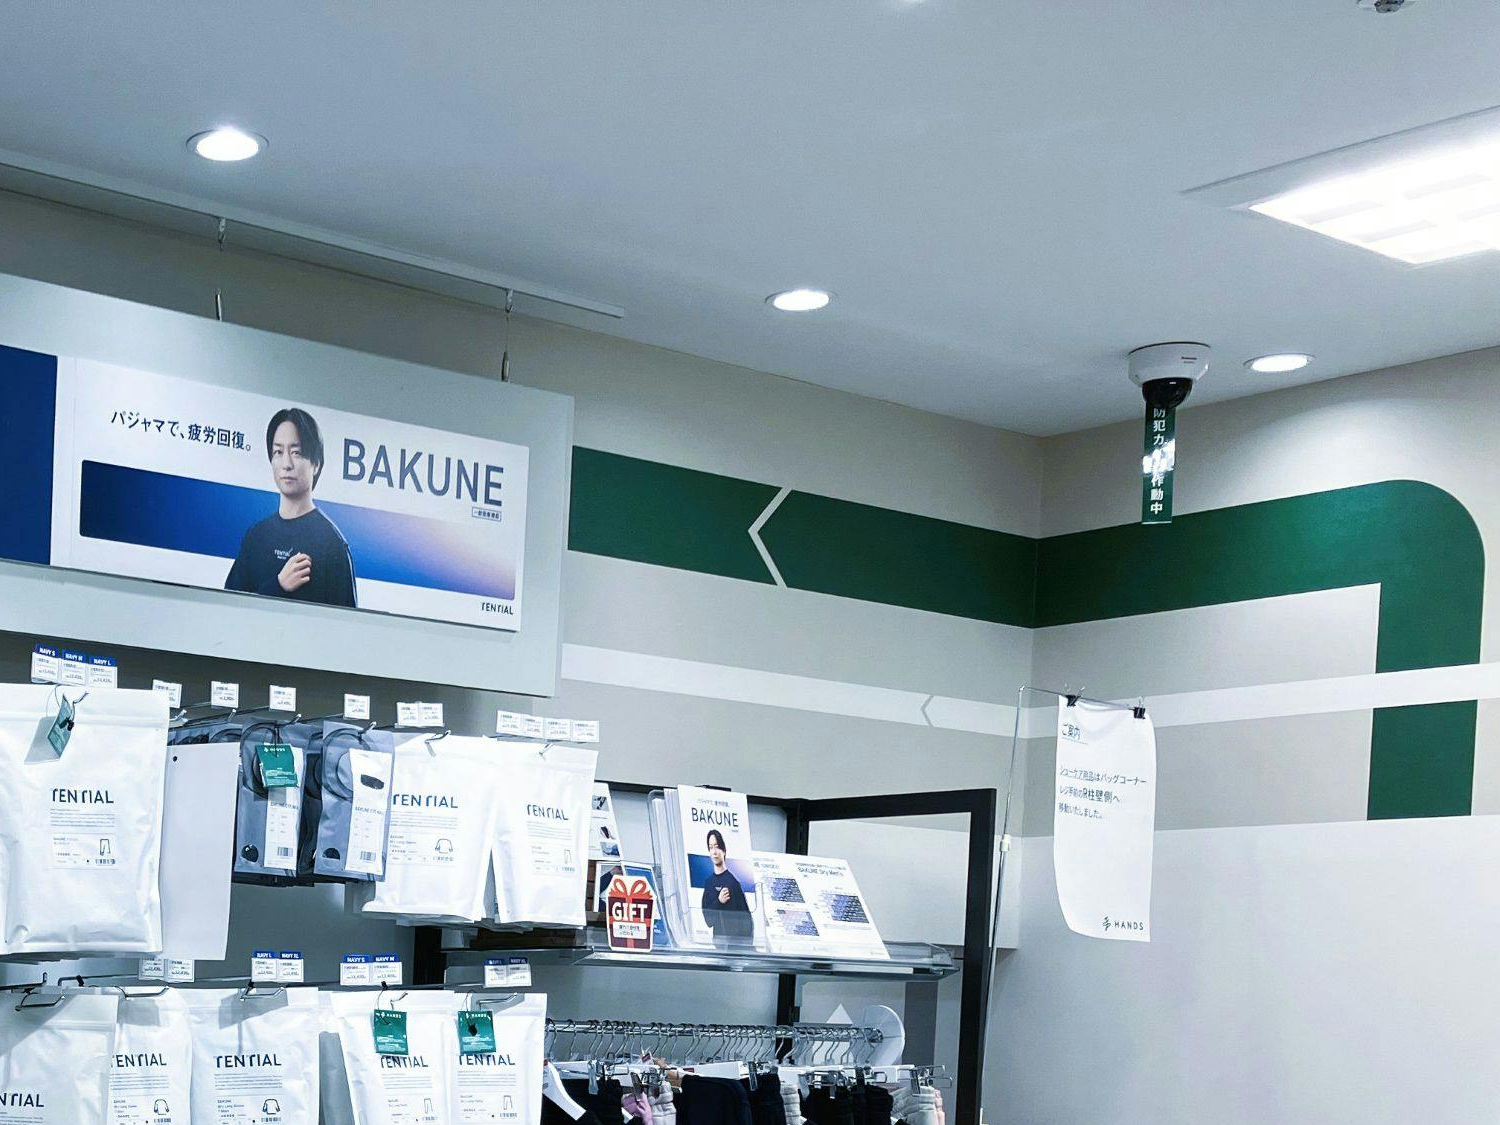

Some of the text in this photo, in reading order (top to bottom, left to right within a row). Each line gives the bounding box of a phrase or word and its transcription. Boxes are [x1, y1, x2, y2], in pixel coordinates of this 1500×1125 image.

[111, 409, 252, 453] パジャマで、疲労回復。
[1150, 408, 1166, 514] 防犯カ作動中
[341, 437, 504, 507] BAKUNE
[481, 602, 514, 615] TENTIAL
[53, 789, 114, 803] TENTIAL
[393, 794, 458, 808] TENTIAL
[527, 804, 568, 820] TENTIAL
[691, 807, 738, 827] BAKUNE
[612, 901, 648, 922] GIFT
[1114, 920, 1144, 931] HANDS
[217, 1054, 281, 1068] TENTIAL
[459, 1053, 516, 1067] TENTIAL
